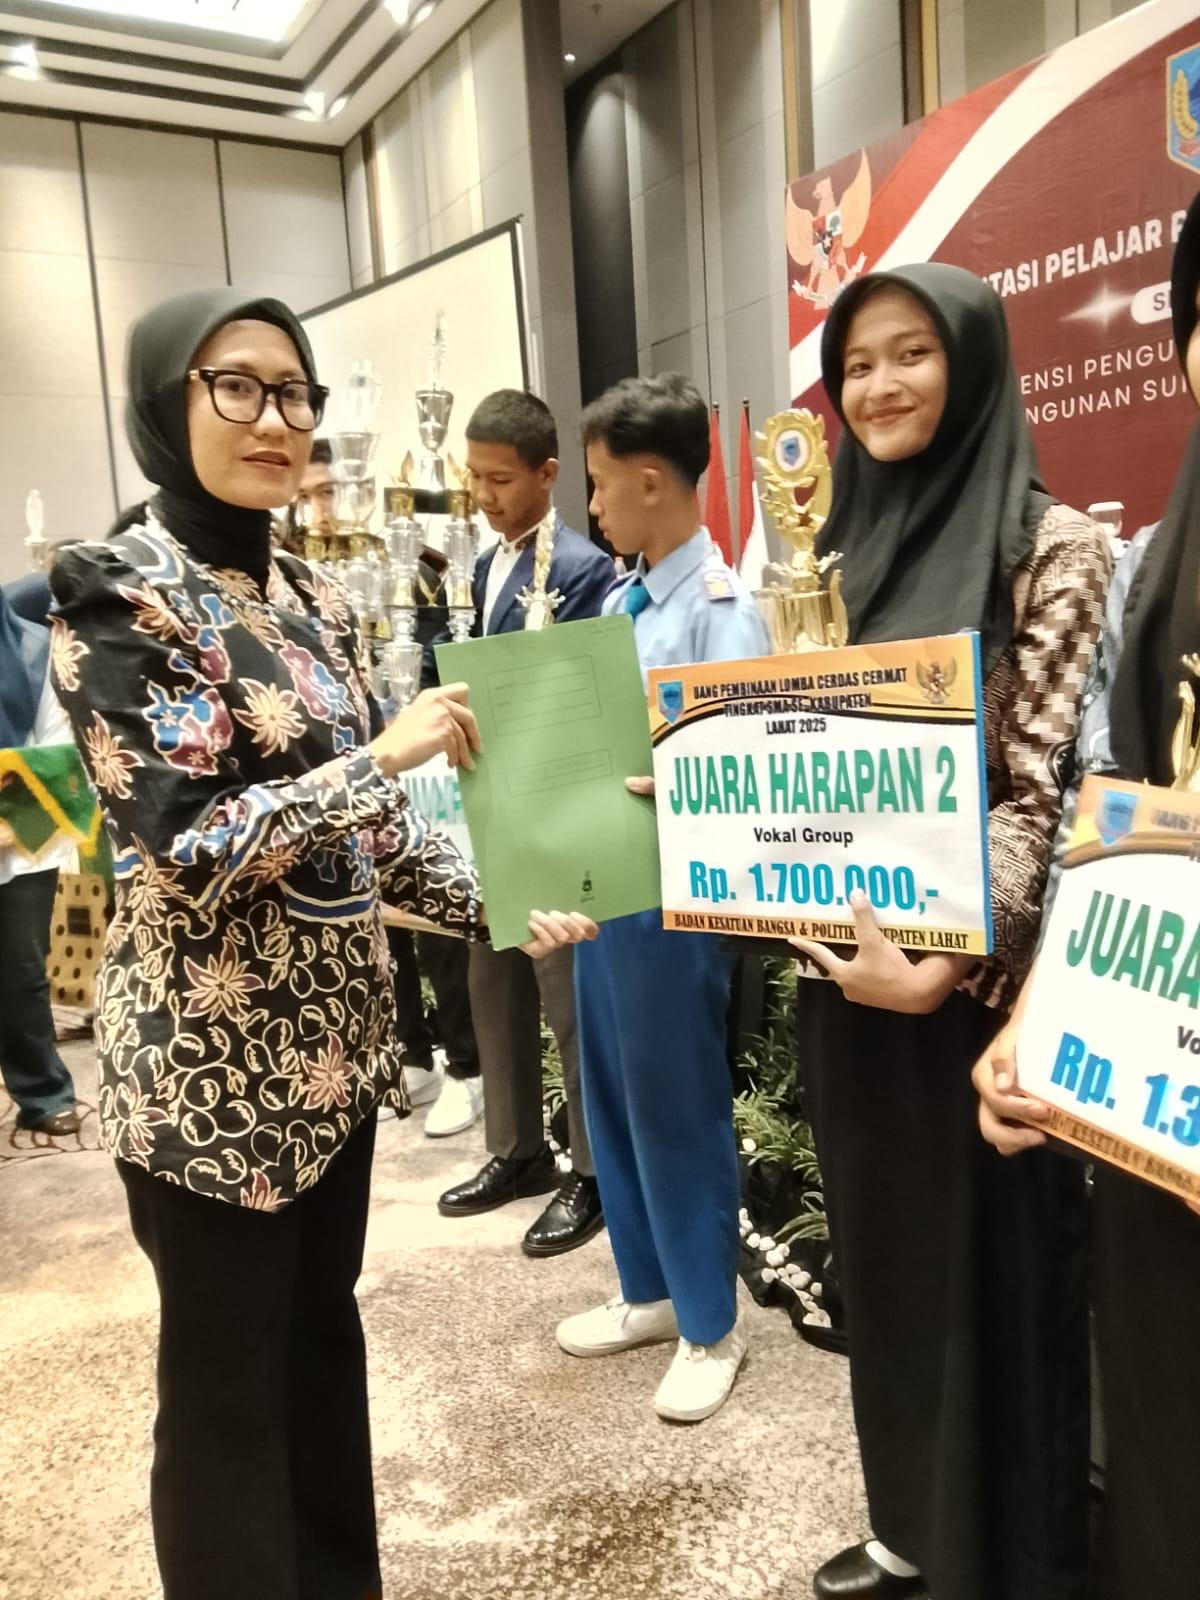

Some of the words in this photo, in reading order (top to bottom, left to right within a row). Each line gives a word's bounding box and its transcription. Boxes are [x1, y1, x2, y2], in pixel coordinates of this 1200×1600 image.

[982, 259, 1039, 298] TASI
[1045, 218, 1163, 284] PELAJAR
[1020, 364, 1073, 396] ENSI
[1084, 339, 1174, 381] PENGU
[1025, 385, 1131, 425] NGUNAN
[1143, 374, 1188, 402] SU
[693, 685, 719, 700] UANG
[720, 679, 777, 698] PEMBINAAN
[779, 675, 815, 693] LOMBA
[817, 672, 859, 690] CERDAS
[862, 667, 908, 686] CERMAT
[766, 719, 796, 735] LAHAT
[799, 717, 827, 734] 2025
[669, 754, 761, 816] JUARA
[768, 746, 925, 815] HARAPAN
[935, 745, 958, 813] 2
[753, 827, 796, 844] Vokal
[802, 828, 854, 848] Group
[689, 861, 737, 904] Rp.
[674, 913, 705, 929] BADAN
[707, 915, 753, 933] KESATUAN
[756, 918, 796, 936] BANGSA
[799, 921, 808, 936] &
[811, 922, 856, 940] POLITIK
[929, 931, 969, 950] LAHAT
[1050, 1032, 1117, 1111] Rp.
